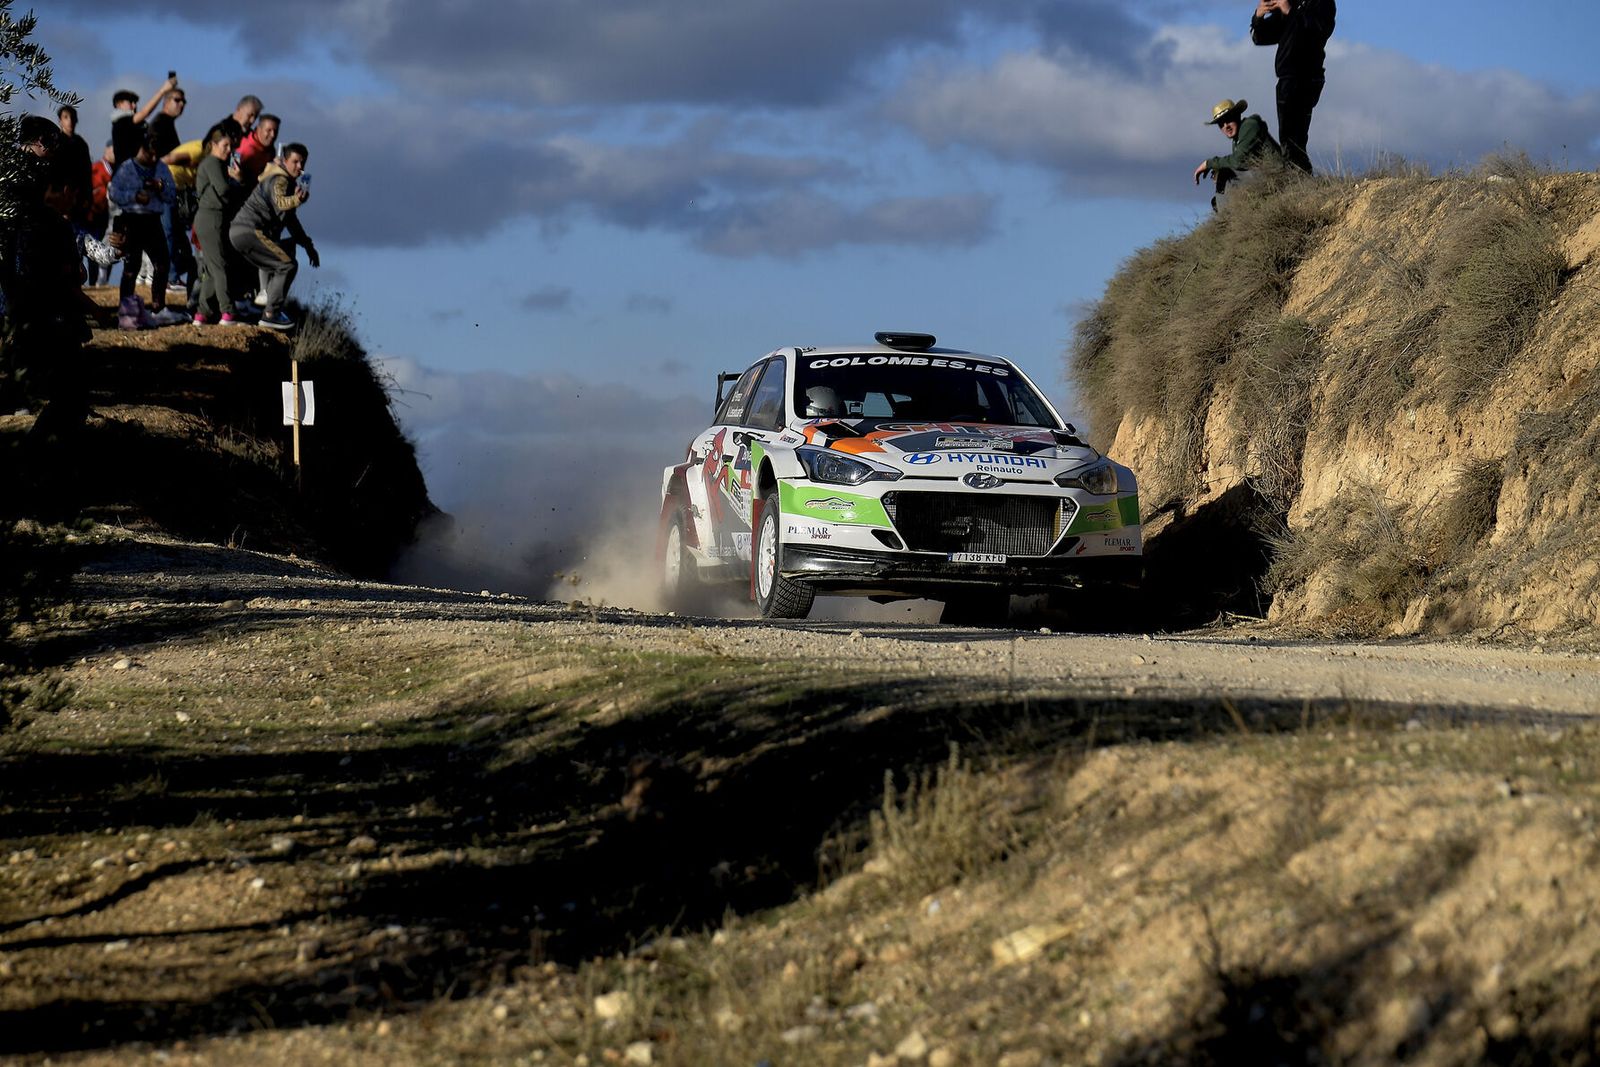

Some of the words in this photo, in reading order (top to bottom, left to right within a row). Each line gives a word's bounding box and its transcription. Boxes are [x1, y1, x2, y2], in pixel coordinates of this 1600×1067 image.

[809, 356, 1010, 377] COLOMBES.ES
[947, 453, 1047, 469] HYUNDAI
[976, 464, 1023, 475] Reinauto
